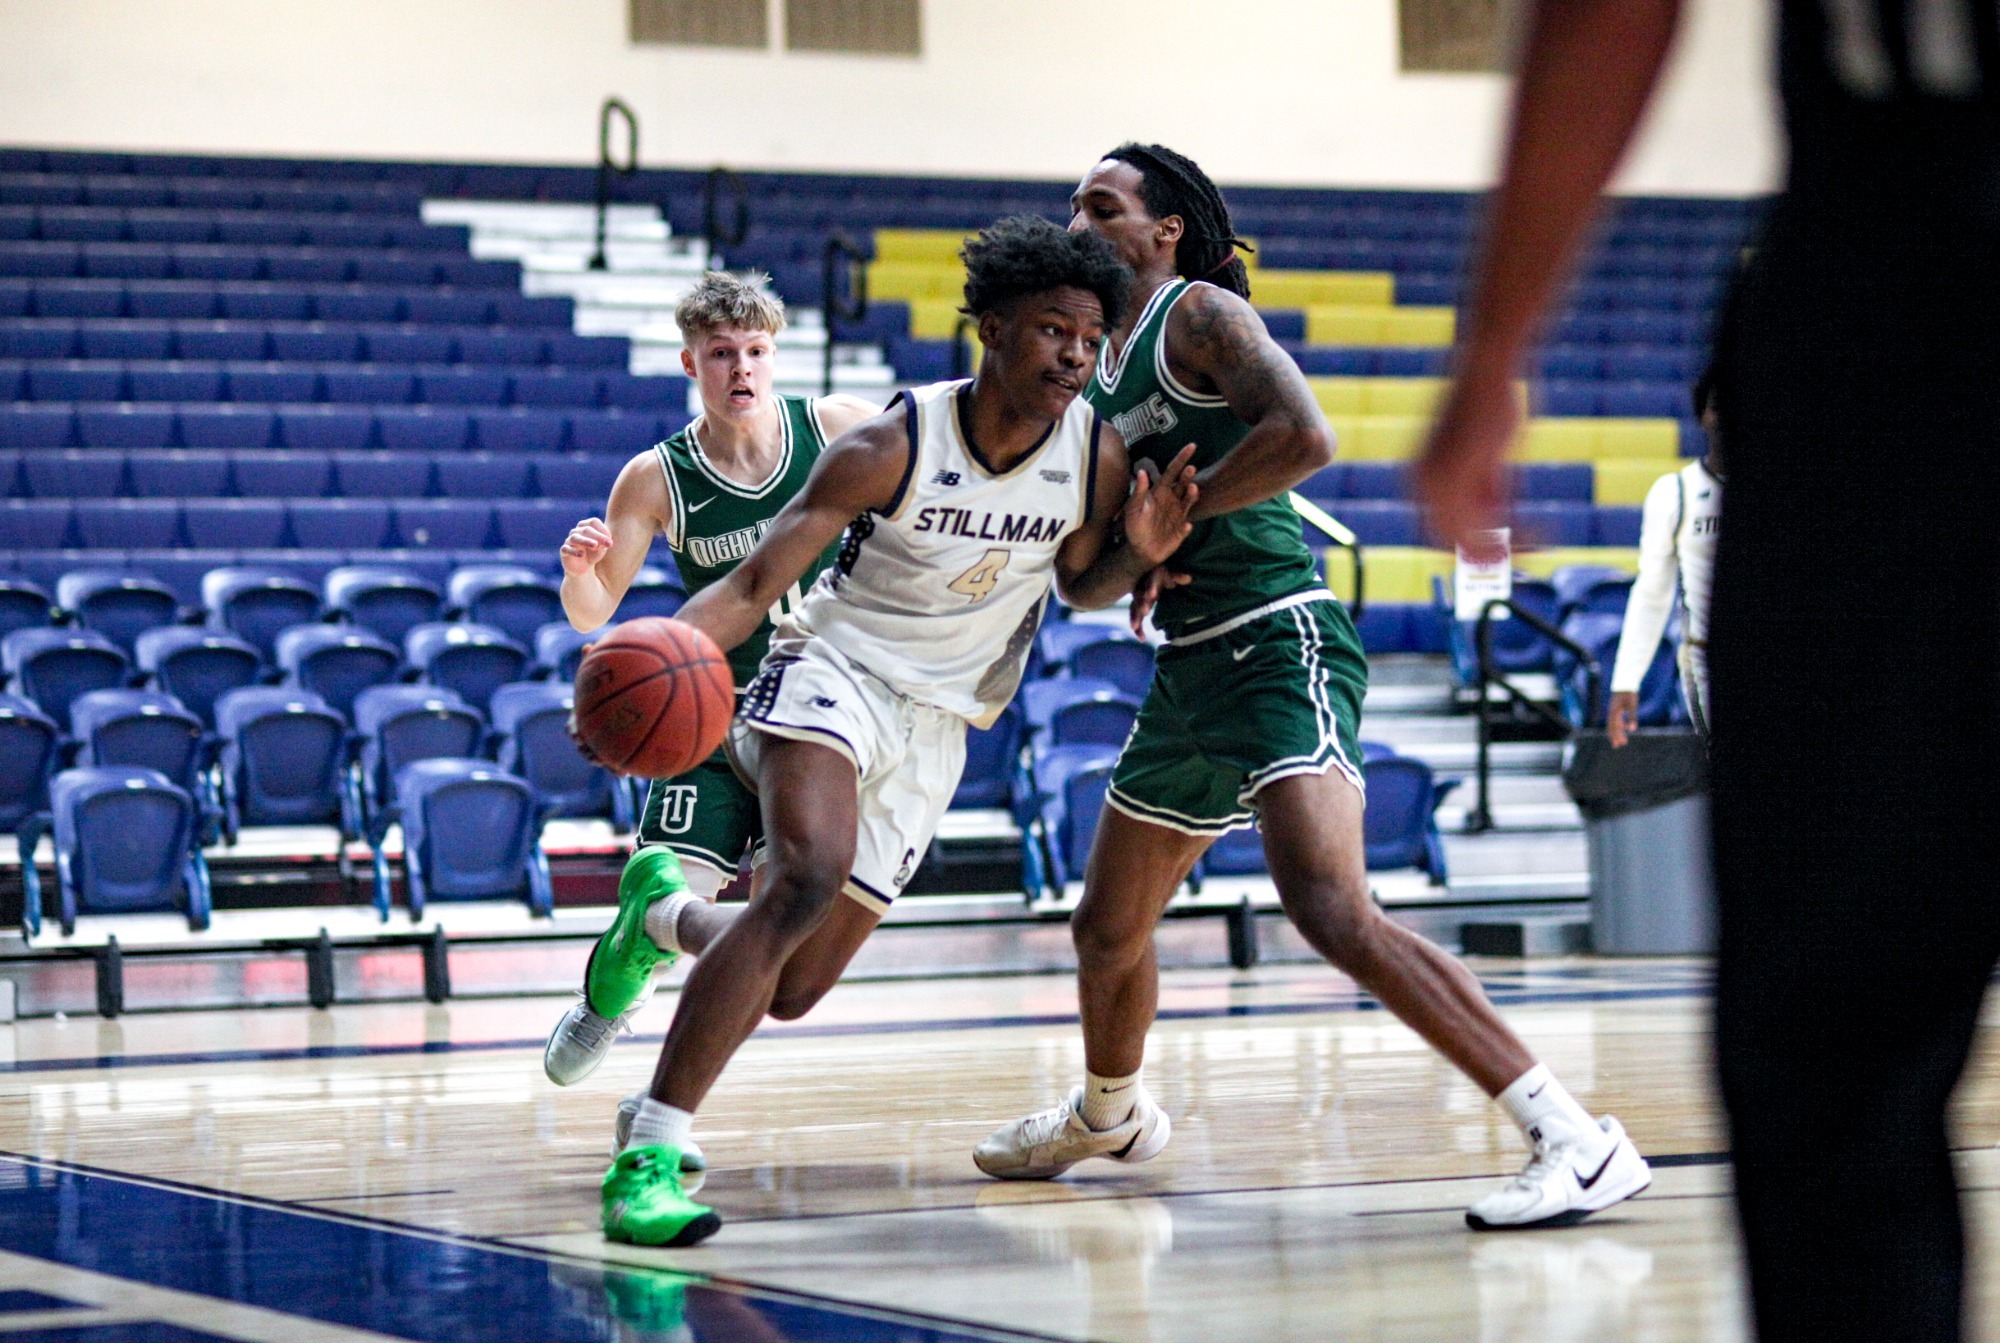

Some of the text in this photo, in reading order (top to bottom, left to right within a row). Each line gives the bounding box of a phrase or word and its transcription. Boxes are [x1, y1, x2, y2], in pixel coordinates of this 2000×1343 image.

[914, 507, 1066, 542] STILLMAN
[687, 526, 757, 567] NIGHT
[947, 548, 1011, 604] 4
